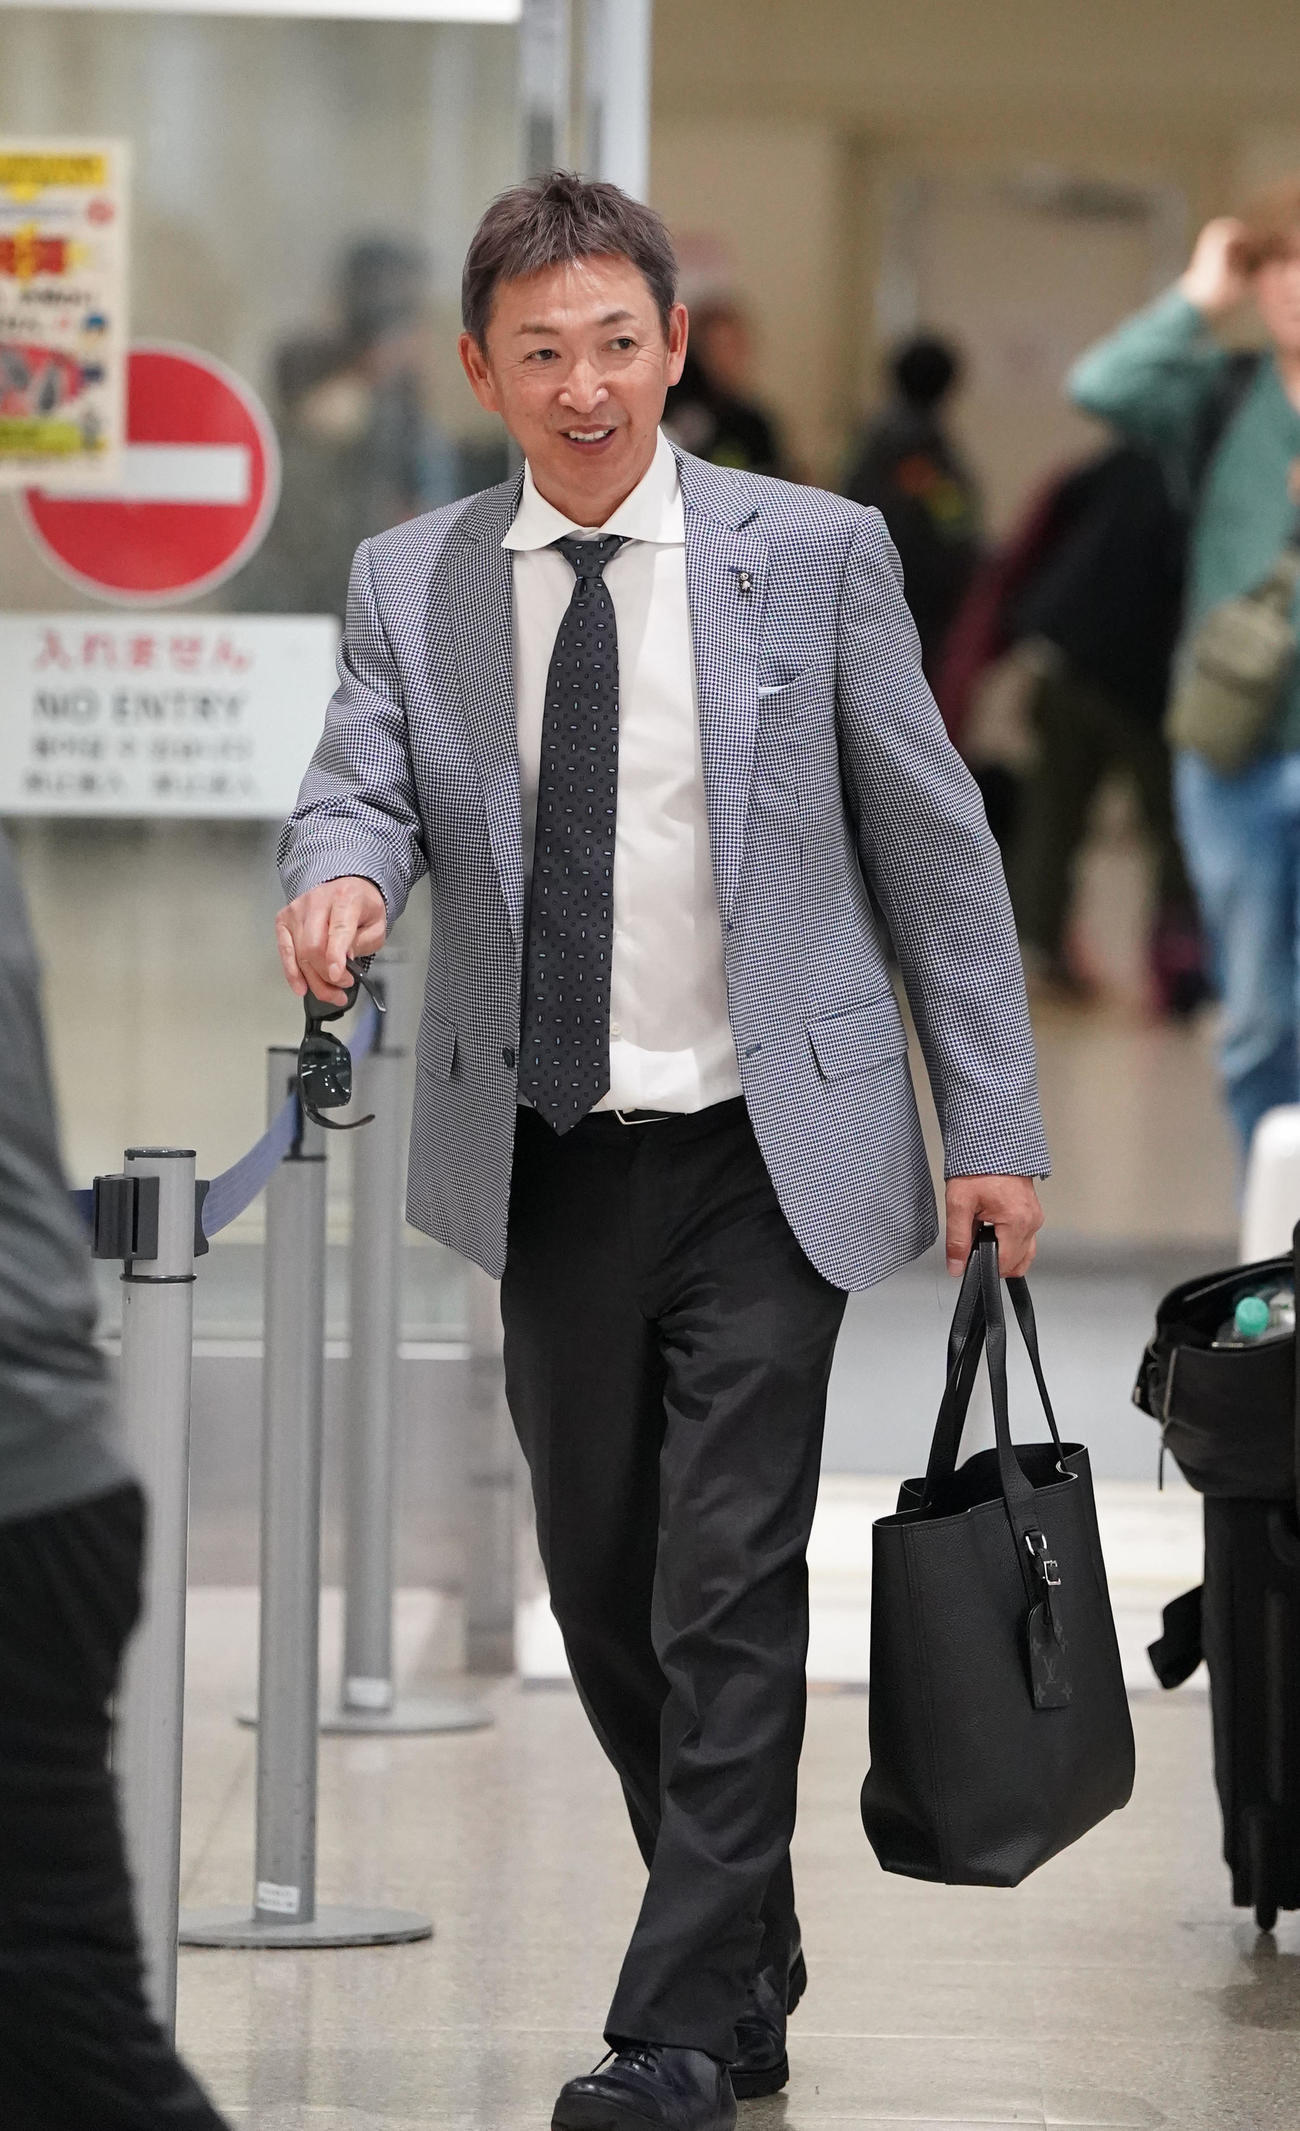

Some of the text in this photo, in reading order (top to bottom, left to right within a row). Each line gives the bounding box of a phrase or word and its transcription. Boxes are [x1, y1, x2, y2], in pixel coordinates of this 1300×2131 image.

[34, 628, 252, 671] 入れません
[33, 688, 247, 721] NO ENTRY
